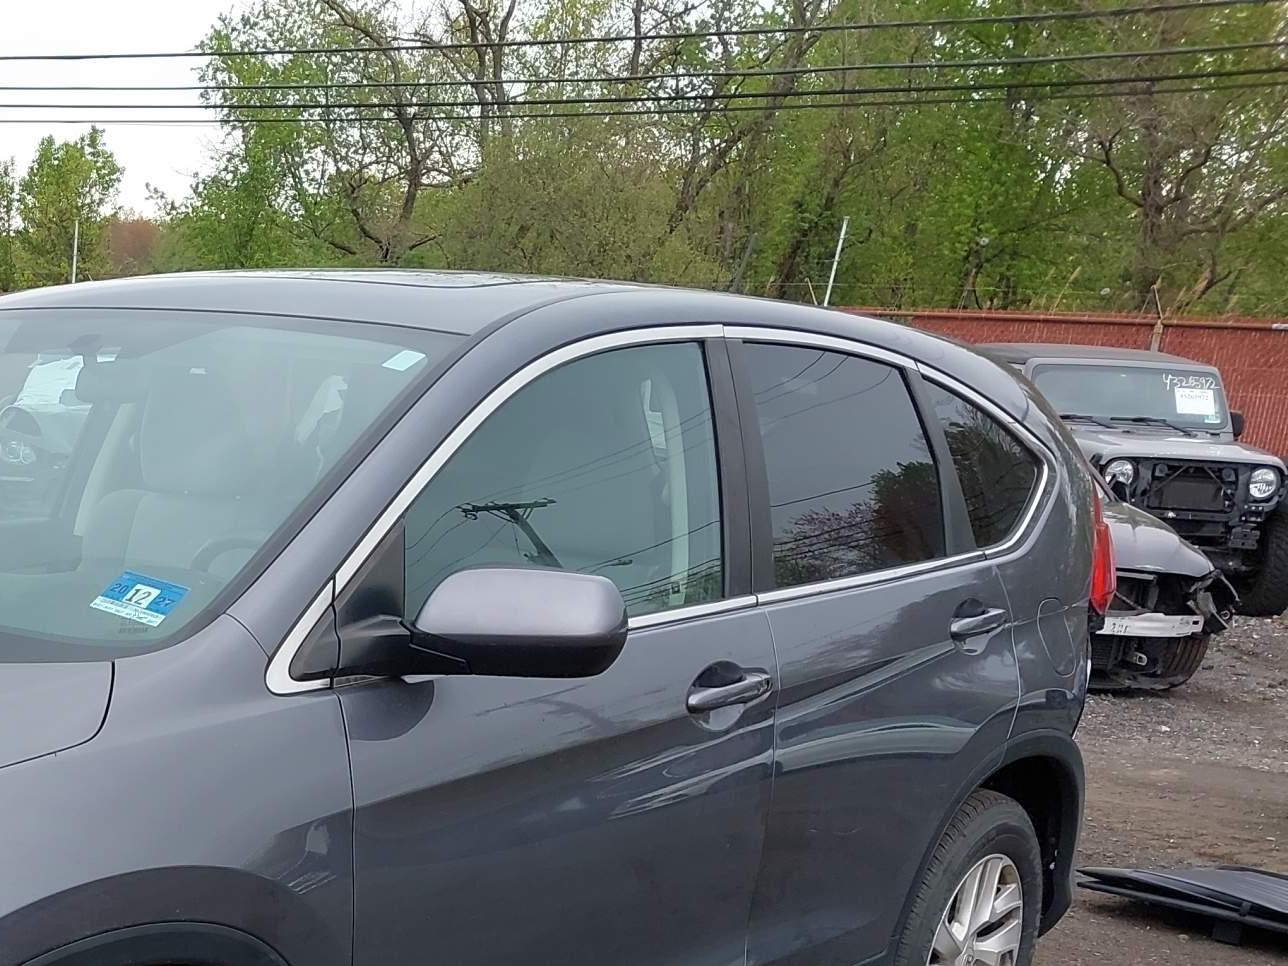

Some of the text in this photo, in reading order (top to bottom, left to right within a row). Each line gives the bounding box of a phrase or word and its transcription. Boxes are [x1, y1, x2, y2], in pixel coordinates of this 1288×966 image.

[110, 583, 175, 608] 20 12 27
